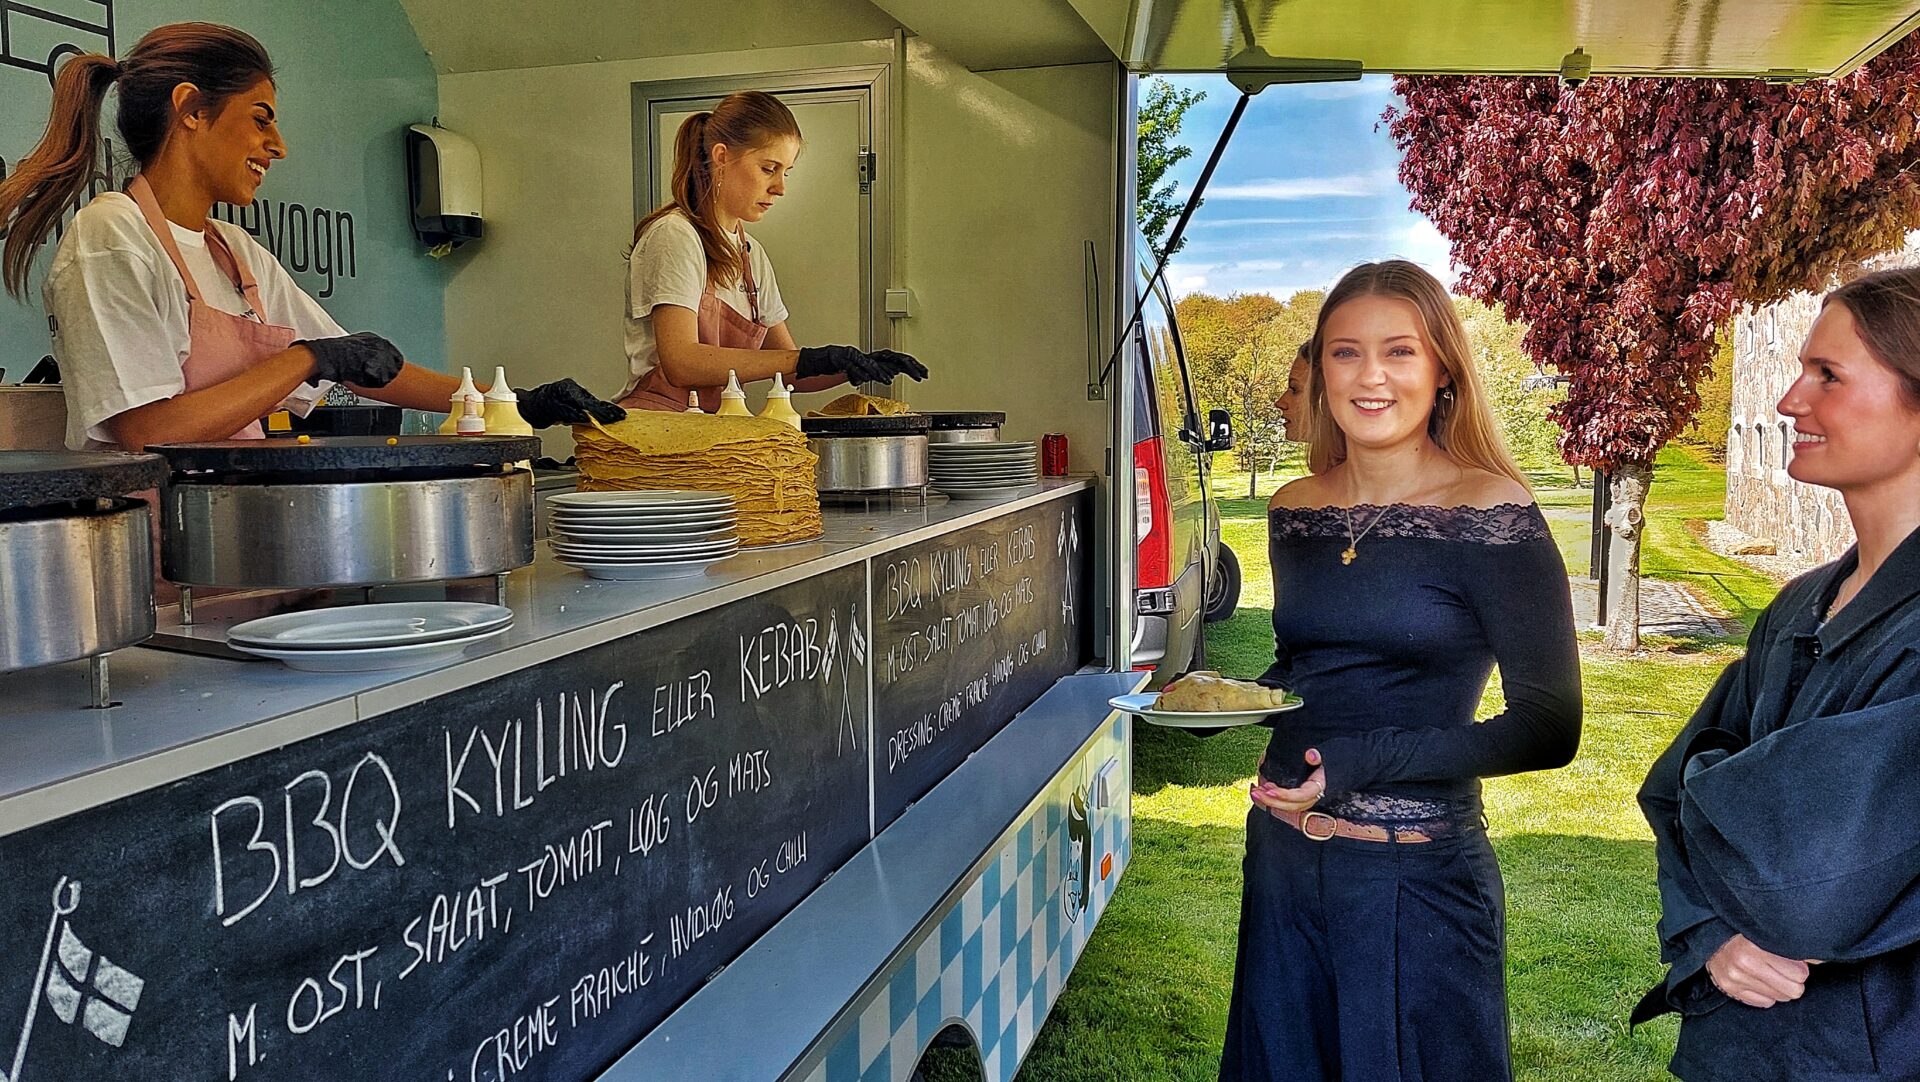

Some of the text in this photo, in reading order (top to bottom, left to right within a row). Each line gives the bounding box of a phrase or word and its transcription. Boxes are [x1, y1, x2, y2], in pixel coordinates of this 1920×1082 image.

[886, 524, 1036, 621] BBQ KYLLING ELLER KEBAB
[1000, 589, 1012, 619] OG
[1018, 642, 1029, 667] OG
[211, 618, 822, 927] BBQ KYLLING ELLER KEBAB
[228, 1002, 266, 1082] M.
[287, 945, 382, 1034] OST,
[399, 872, 513, 980] SALAT,
[629, 793, 670, 857] LØG
[686, 765, 718, 824] OG
[729, 749, 771, 798] MAJS
[670, 884, 734, 960] HVIDLØG
[747, 858, 770, 898] OG
